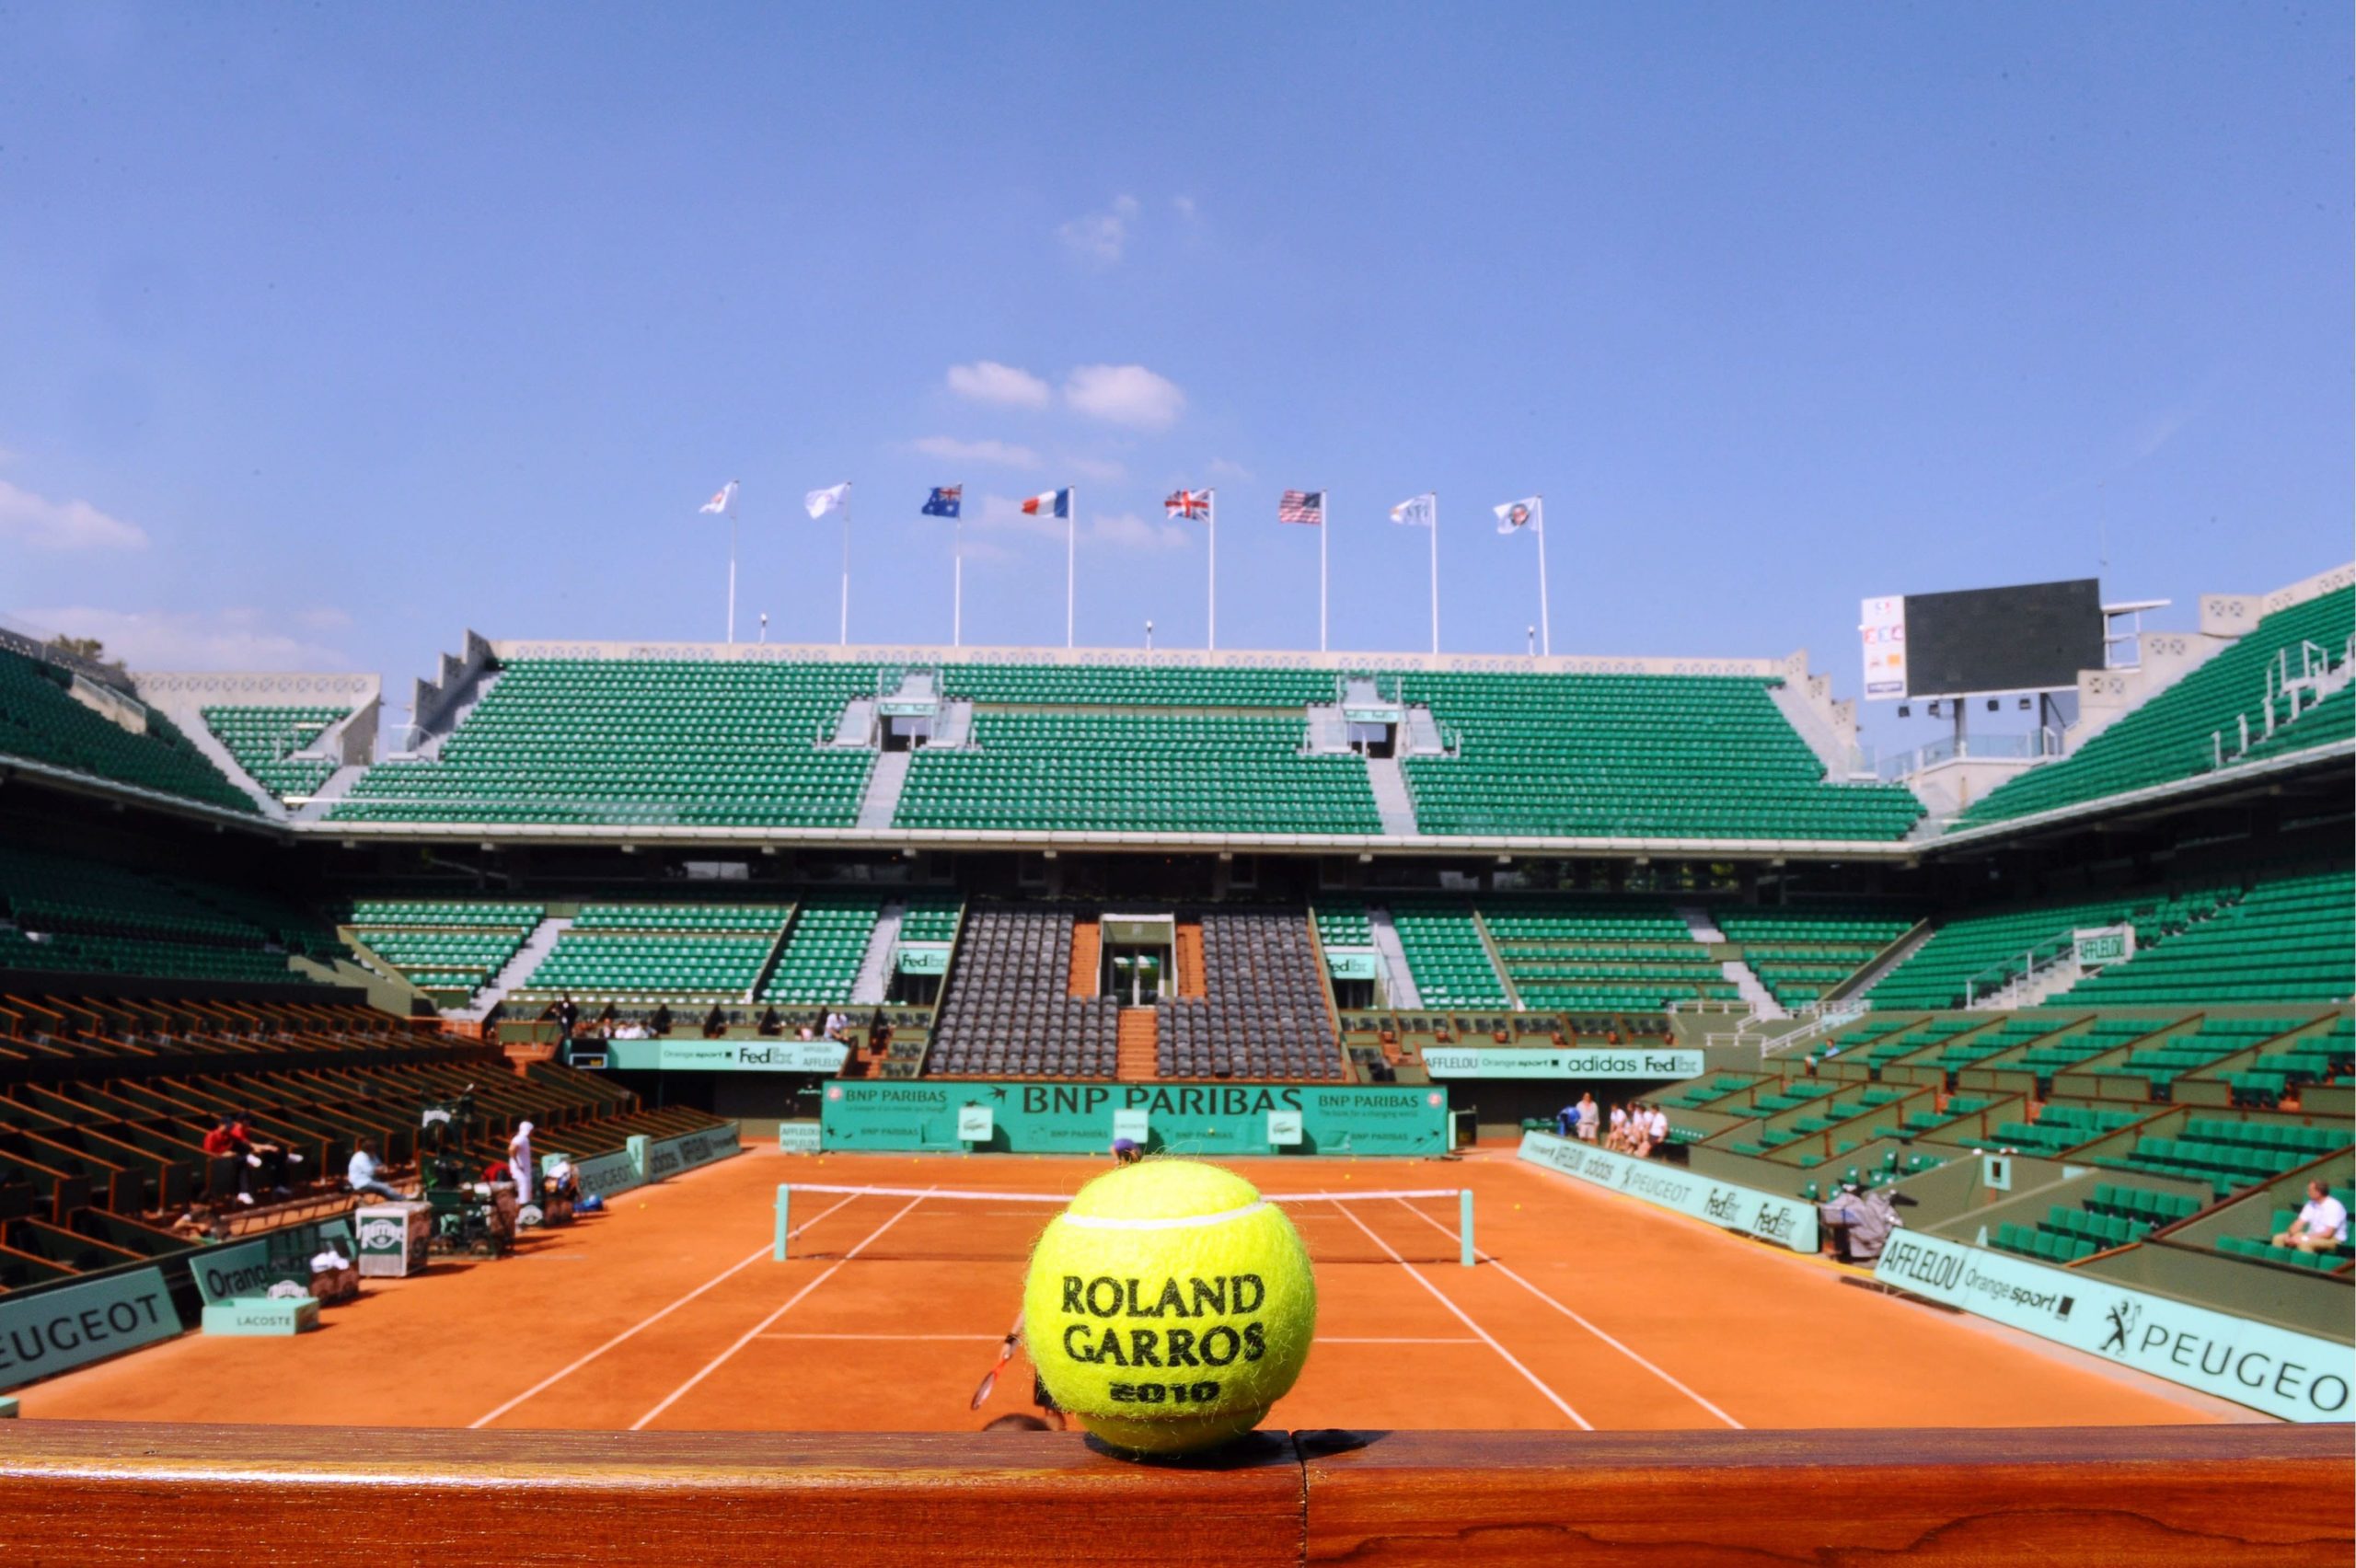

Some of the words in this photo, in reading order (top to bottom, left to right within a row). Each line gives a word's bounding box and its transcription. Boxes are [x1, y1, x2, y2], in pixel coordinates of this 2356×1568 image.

[1568, 1055, 1636, 1072] adidas
[846, 1090, 878, 1102] BNP
[882, 1090, 947, 1103] PARIBAS
[1023, 1086, 1110, 1114] BNP
[1125, 1086, 1303, 1116] PARIBAS
[1319, 1095, 1350, 1107] BNP
[1354, 1095, 1419, 1108] PARIBAS
[1631, 1171, 1692, 1204] PEUGEOT
[1061, 1274, 1265, 1318] ROLAND
[237, 1316, 291, 1327] LACOSTE
[1881, 1240, 1966, 1290] AFFLELOU
[2141, 1324, 2349, 1412] PEUGEO
[1063, 1321, 1266, 1367] GARROS
[1109, 1380, 1220, 1403] 2010
